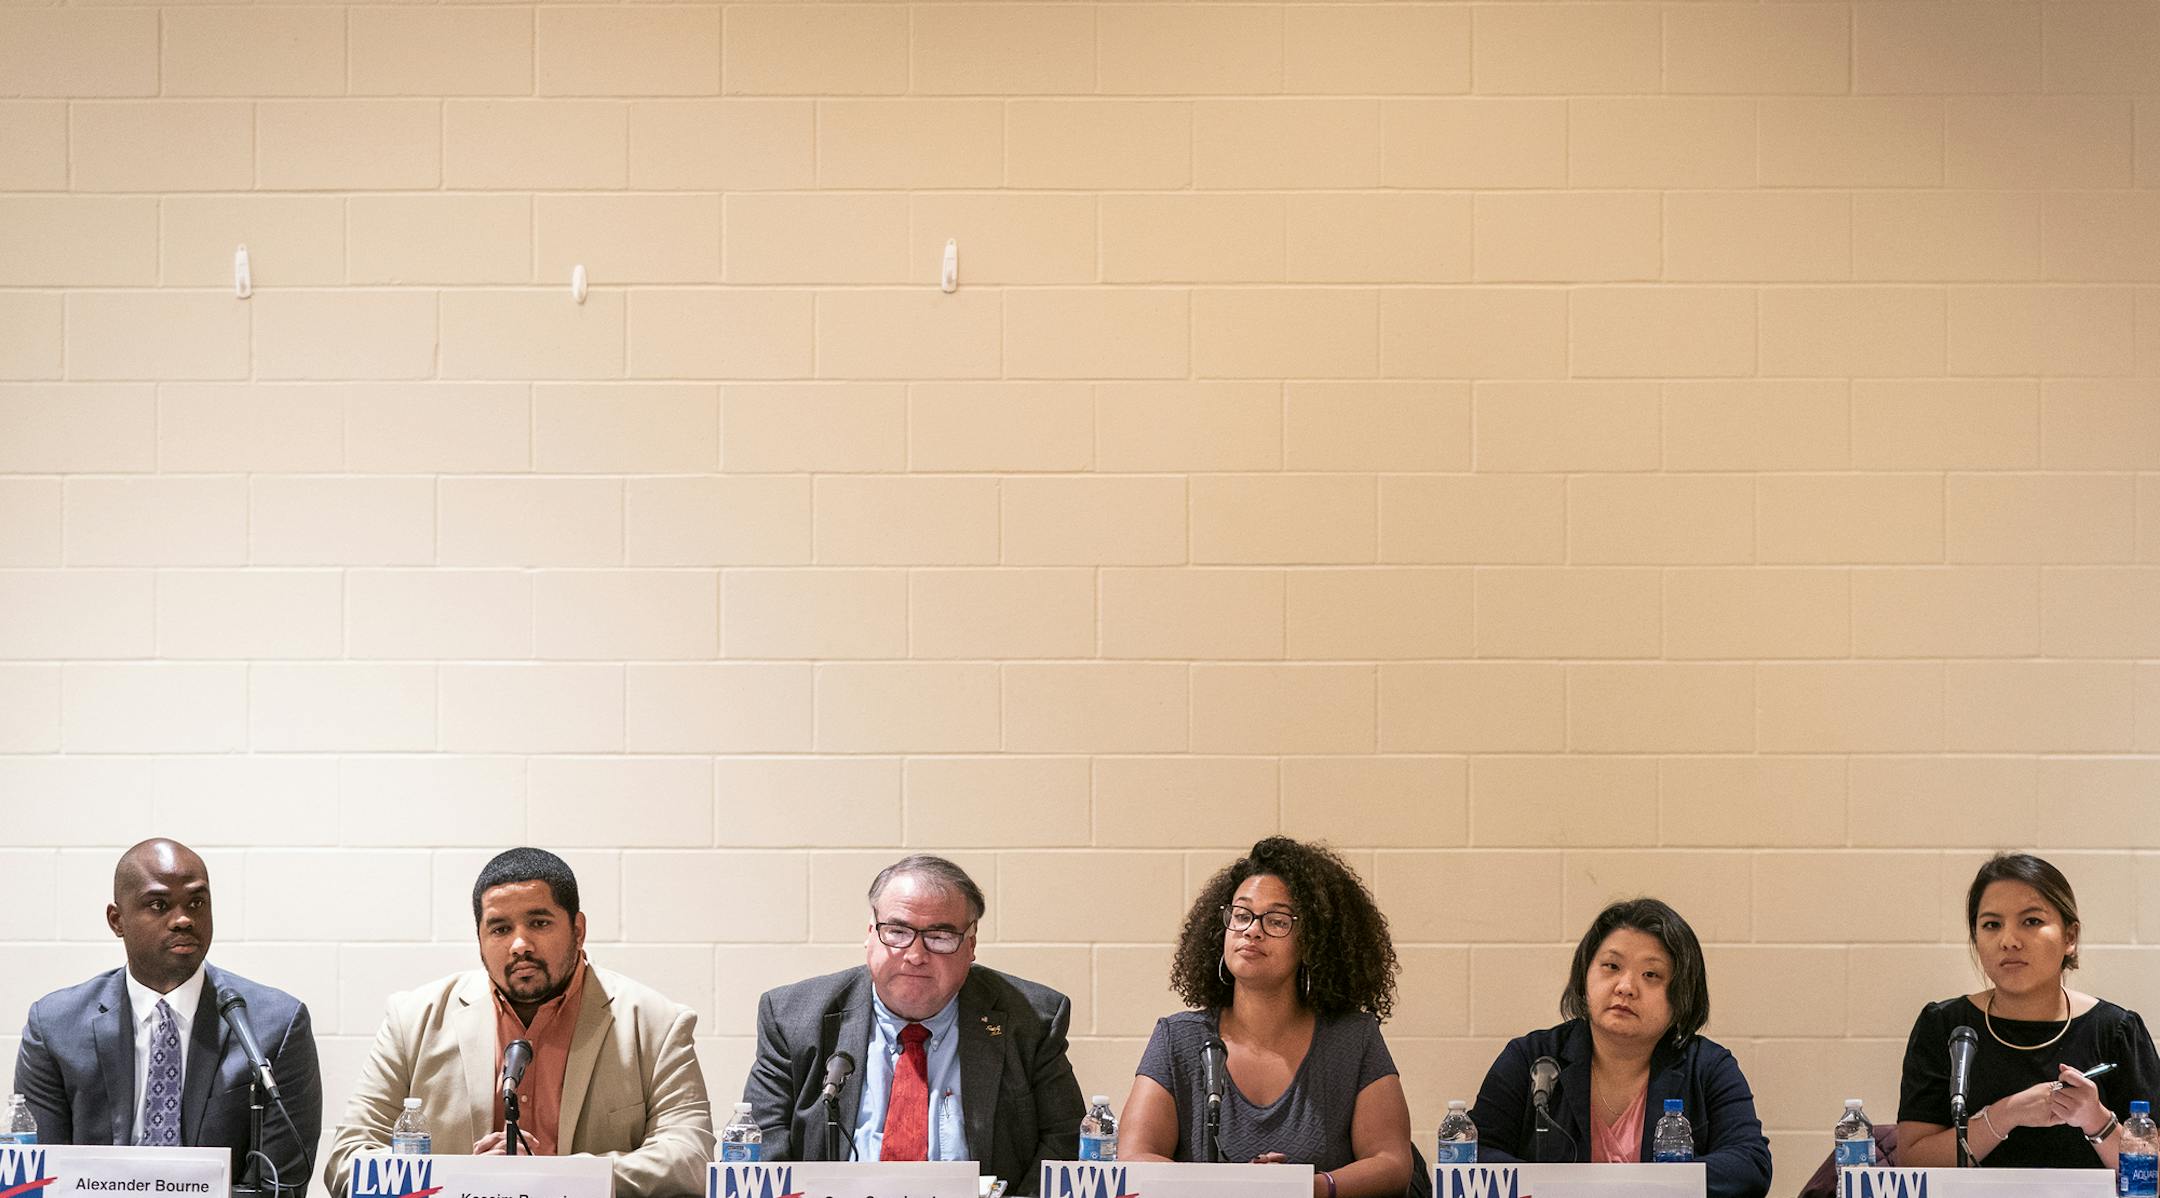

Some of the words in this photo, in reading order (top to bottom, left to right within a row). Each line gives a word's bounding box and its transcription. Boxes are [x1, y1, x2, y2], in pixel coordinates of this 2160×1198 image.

[76, 1178, 151, 1191] Alexander
[155, 1179, 209, 1192] Bourne
[354, 1158, 433, 1195] LWV
[711, 1166, 792, 1198] LWV
[1046, 1166, 1127, 1198] LWV
